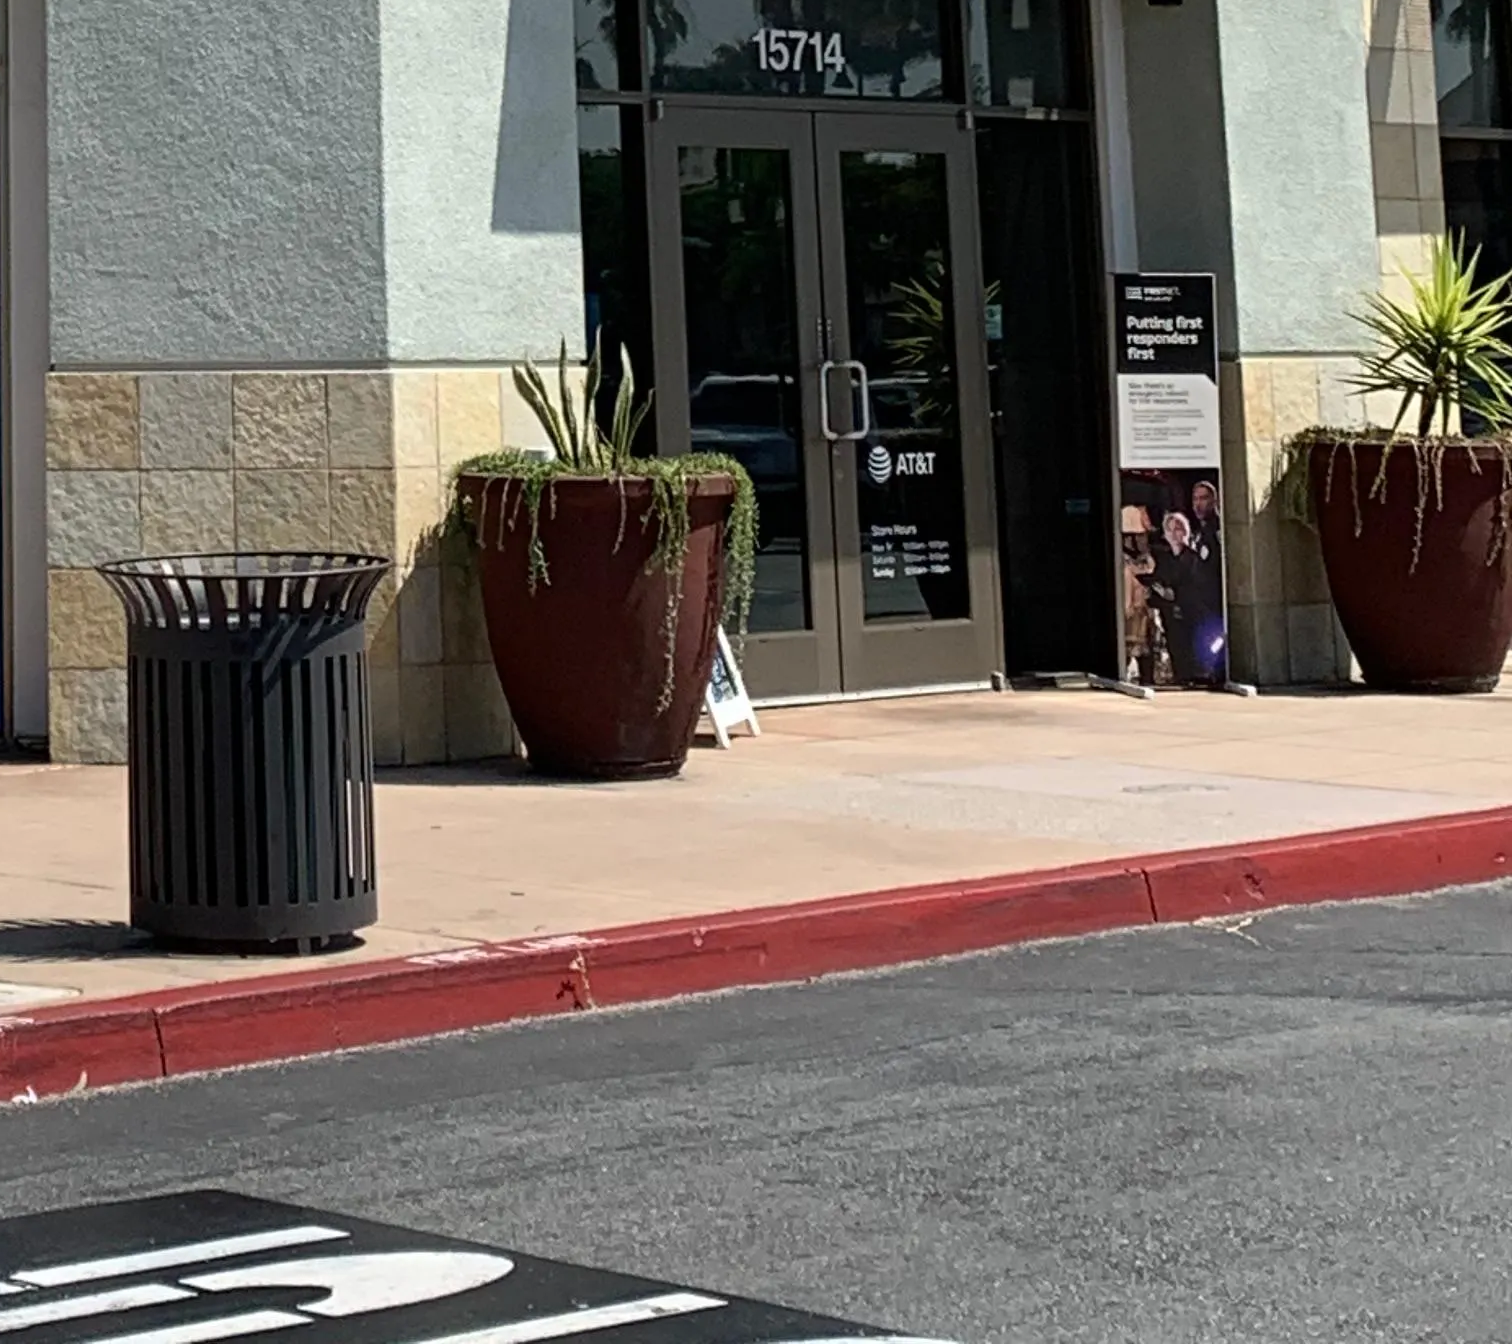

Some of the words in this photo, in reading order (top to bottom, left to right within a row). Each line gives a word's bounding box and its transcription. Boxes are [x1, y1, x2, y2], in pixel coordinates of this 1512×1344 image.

[752, 28, 846, 72] 15714
[1126, 315, 1174, 332] Putting
[1175, 315, 1204, 330] first
[1126, 332, 1199, 347] responders
[1126, 347, 1156, 361] first
[895, 452, 936, 476] AT&T
[893, 523, 918, 536] Hours
